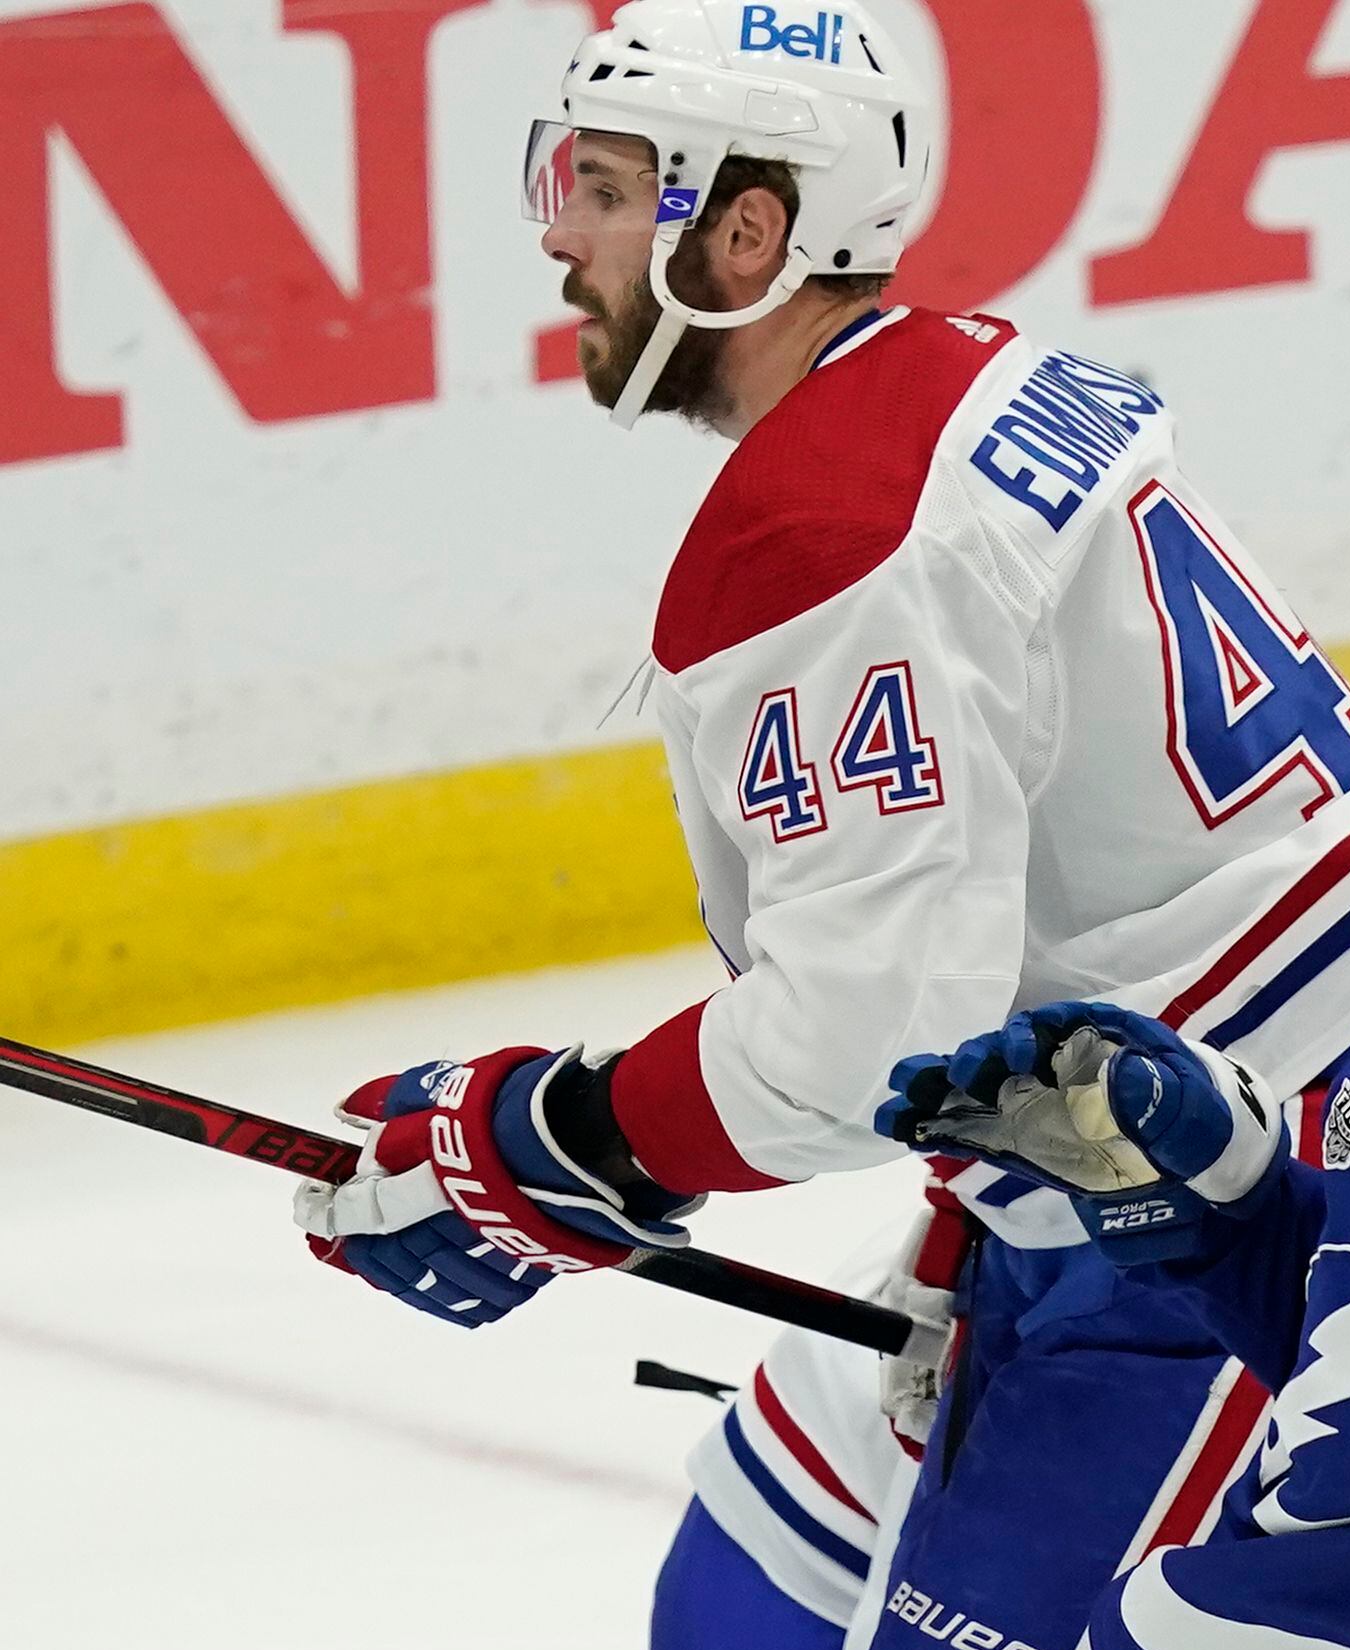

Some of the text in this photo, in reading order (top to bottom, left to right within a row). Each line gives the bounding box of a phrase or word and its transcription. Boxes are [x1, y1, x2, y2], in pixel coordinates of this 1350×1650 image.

[740, 5, 843, 64] Bell
[738, 659, 945, 844] 44
[1102, 1207, 1176, 1230] CCM
